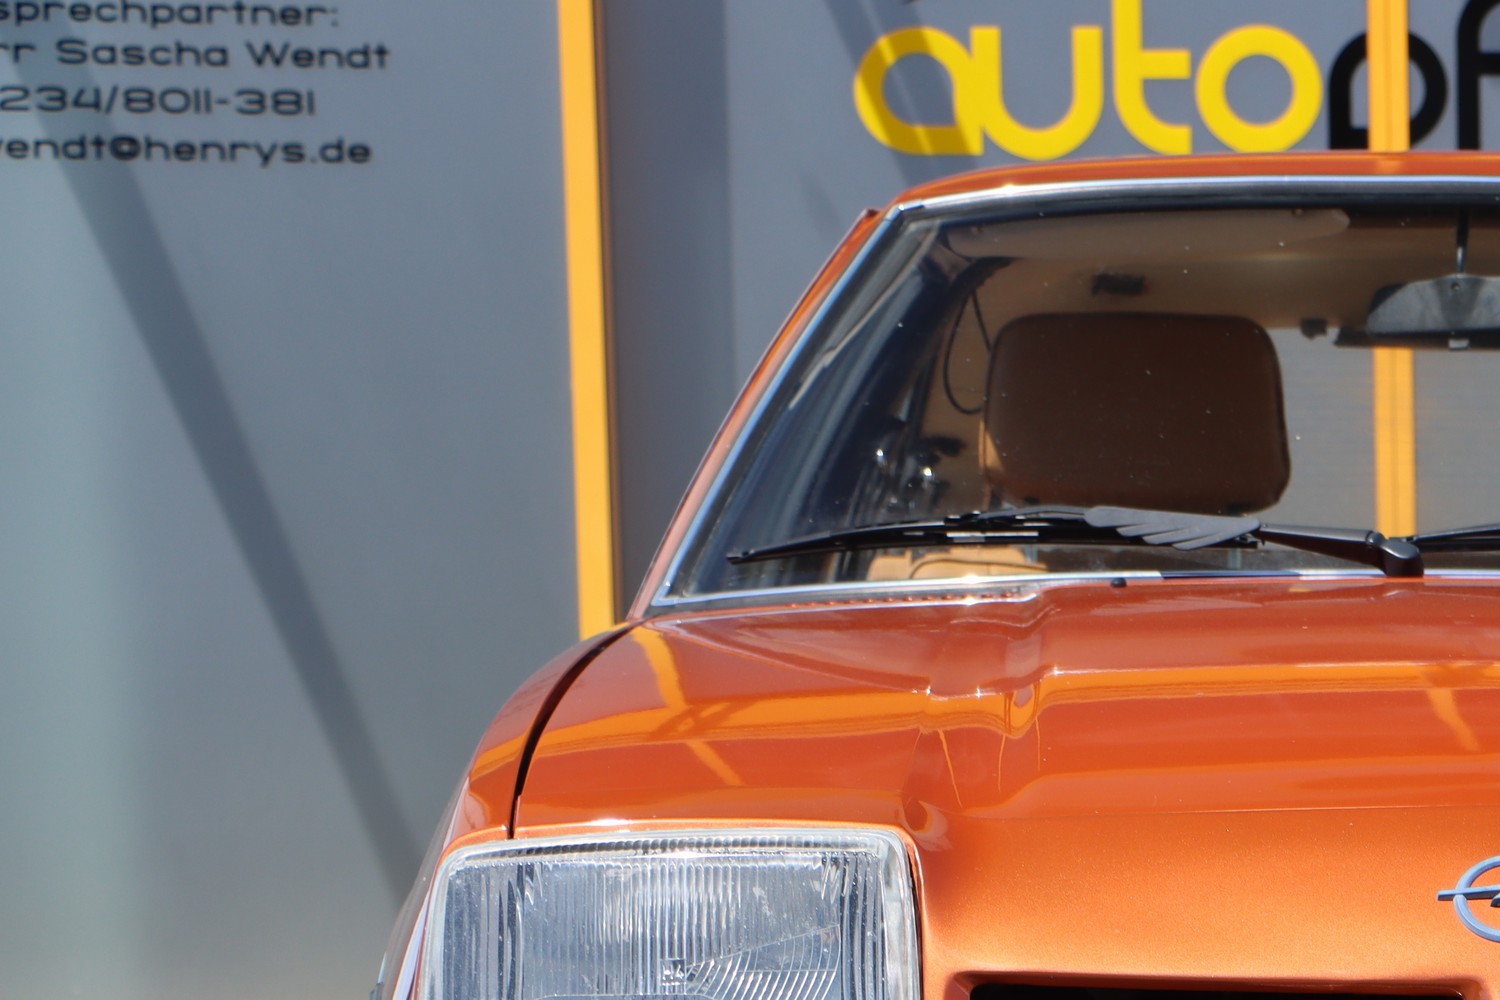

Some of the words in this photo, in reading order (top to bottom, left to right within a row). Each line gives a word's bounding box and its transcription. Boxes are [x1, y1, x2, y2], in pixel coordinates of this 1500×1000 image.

[56, 37, 229, 67] Sascha
[245, 41, 390, 69] Wendt
[0, 133, 372, 167] endt@henrys.de
